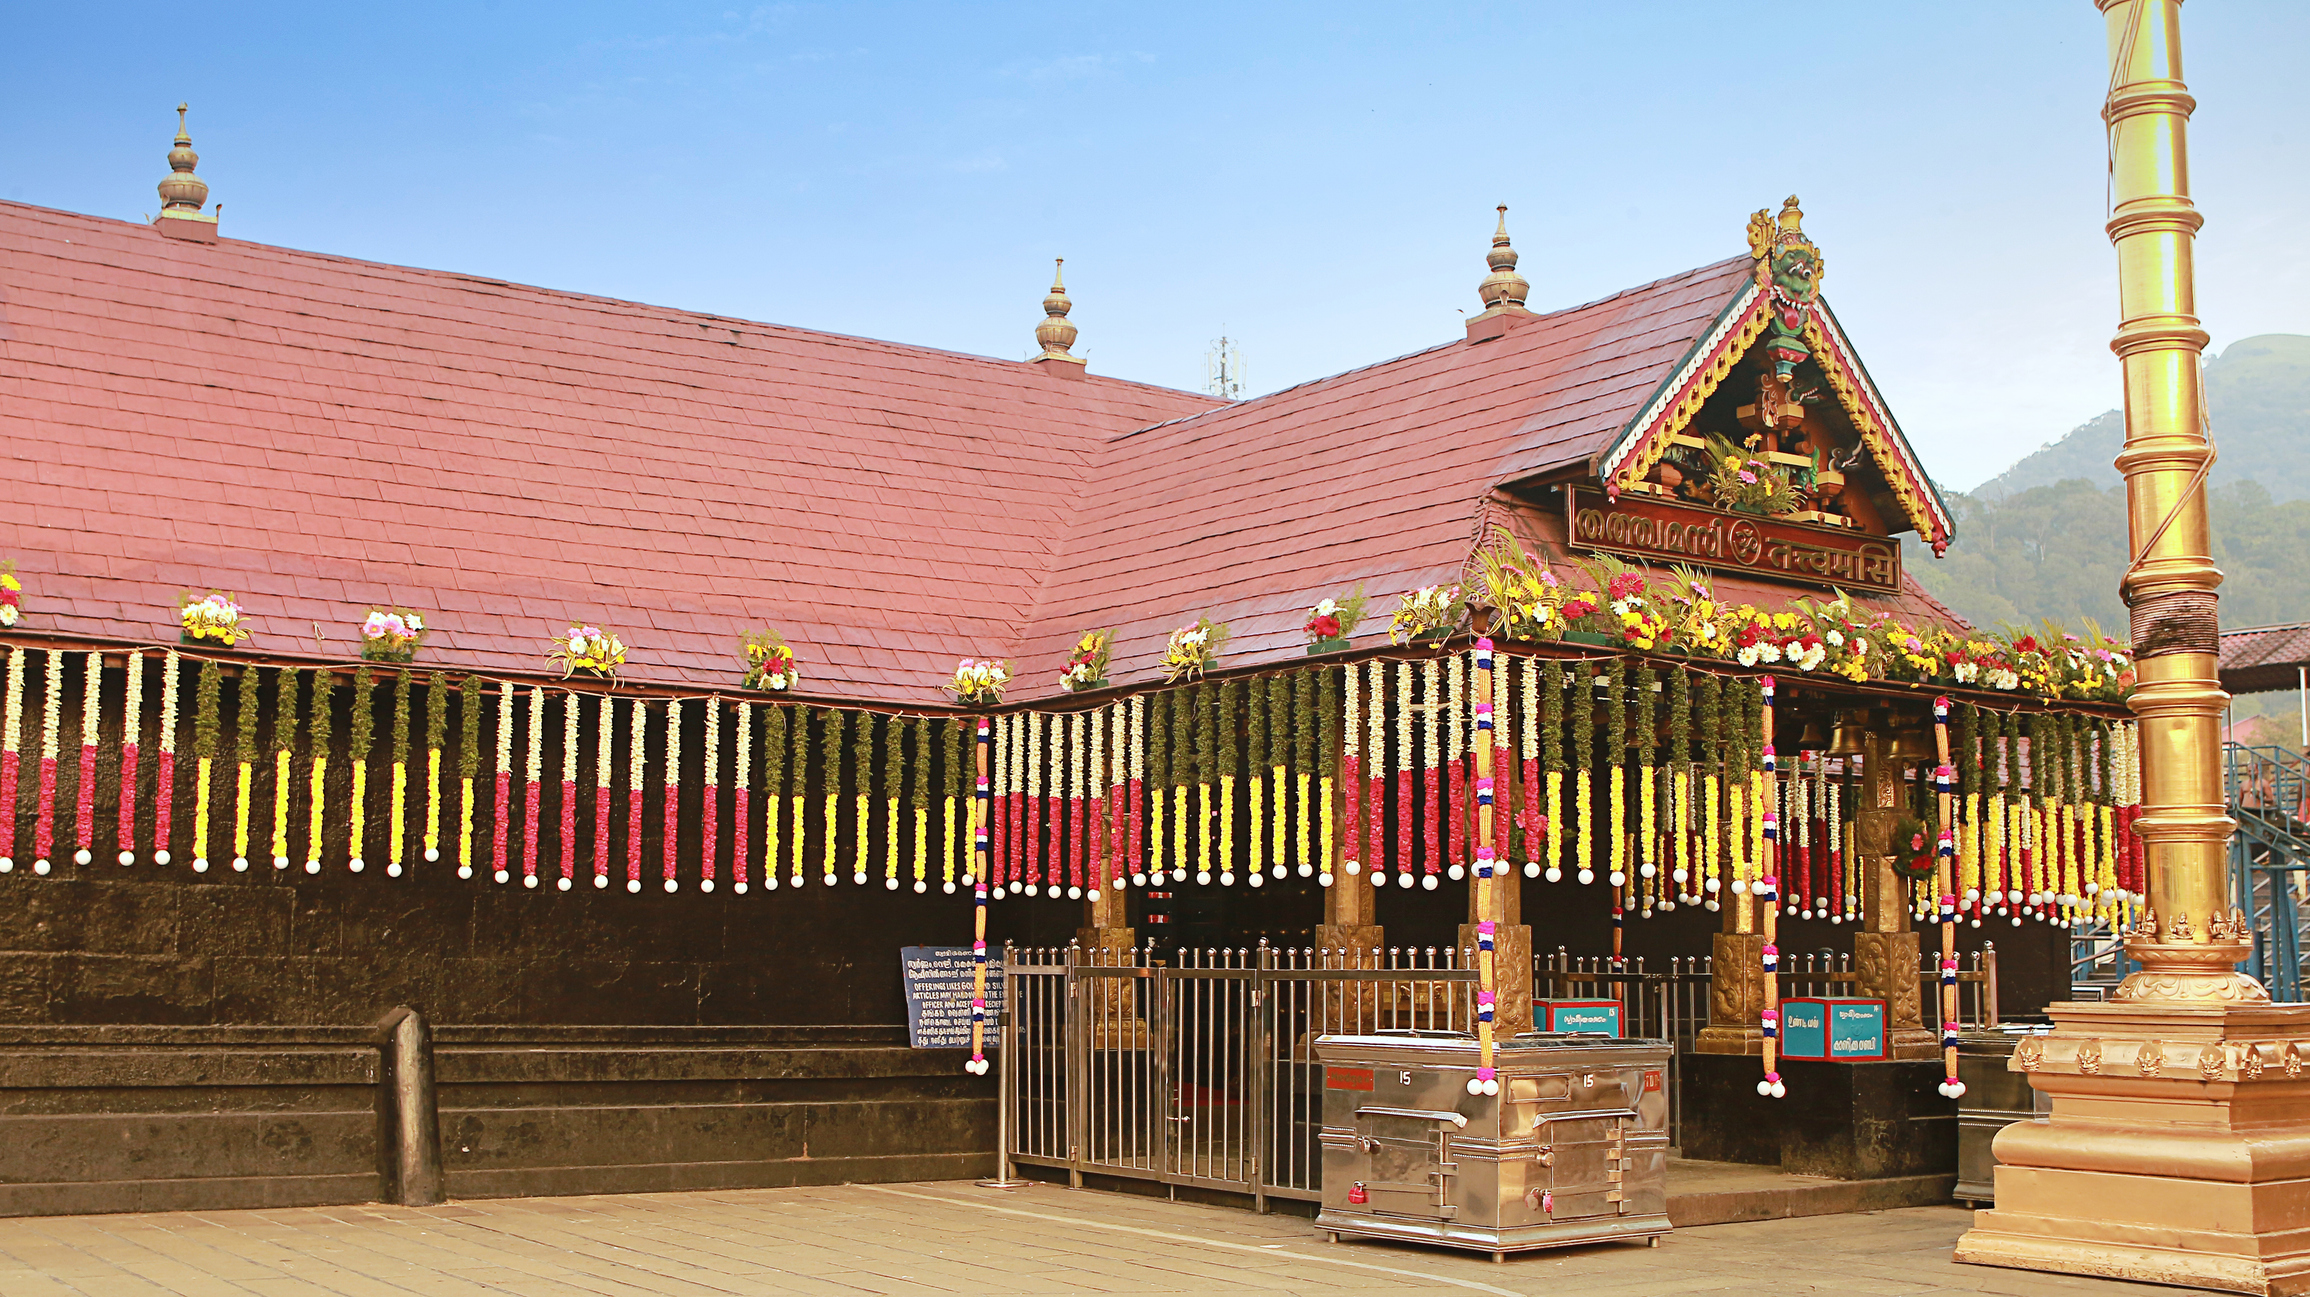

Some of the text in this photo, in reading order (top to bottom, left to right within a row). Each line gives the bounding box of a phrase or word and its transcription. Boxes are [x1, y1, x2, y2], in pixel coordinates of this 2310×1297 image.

[914, 982, 946, 991] OFFERINGS
[946, 982, 960, 990] LIKES
[961, 981, 975, 990] GOL
[912, 991, 939, 999] ARTICLES
[922, 1001, 943, 1009] OFFICER
[1399, 1070, 1411, 1086] 15
[1583, 1074, 1594, 1088] 15
